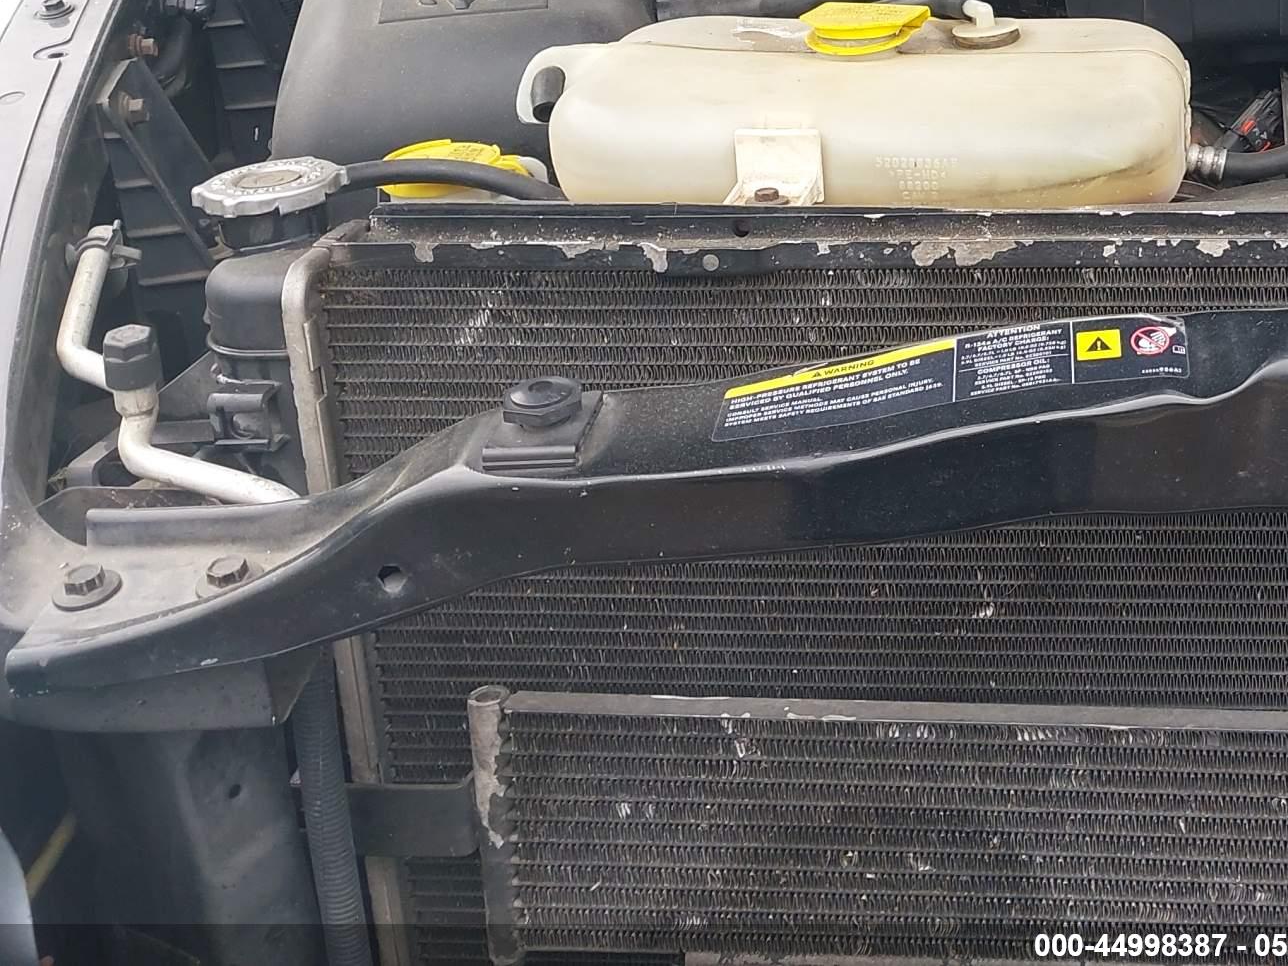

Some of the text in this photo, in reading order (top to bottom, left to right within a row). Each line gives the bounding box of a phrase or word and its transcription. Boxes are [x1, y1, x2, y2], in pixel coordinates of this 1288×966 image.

[987, 324, 1040, 339] ATTENTION
[1008, 329, 1062, 341] REFRIGERANT
[977, 342, 1013, 352] FACTORY
[824, 360, 875, 375] WARNING
[977, 361, 1032, 375] COMPRESSOR
[729, 398, 771, 410] SERVICED
[786, 387, 832, 399] QUALIFIED
[832, 376, 884, 390] PERSONNEL
[885, 369, 908, 379] ONLY.
[731, 385, 801, 404] HIGH-PRESSURE
[802, 374, 860, 392] REFRIGERANT
[862, 365, 895, 379] SYSTEM
[724, 419, 752, 427] SYSTEM
[754, 415, 777, 423] MEETS
[778, 410, 804, 419] SAFETY
[805, 402, 861, 414] REQUIREMENTS
[888, 387, 925, 399] STANDARD
[725, 412, 762, 423] IMPROPER
[764, 407, 792, 415] SERVICE
[794, 402, 828, 410] METHODS
[846, 394, 869, 402] CAUSE
[871, 385, 907, 397] PERSONAL
[908, 378, 934, 388] INJURY.
[727, 408, 759, 417] CONSULT
[761, 403, 790, 412] SERVICE
